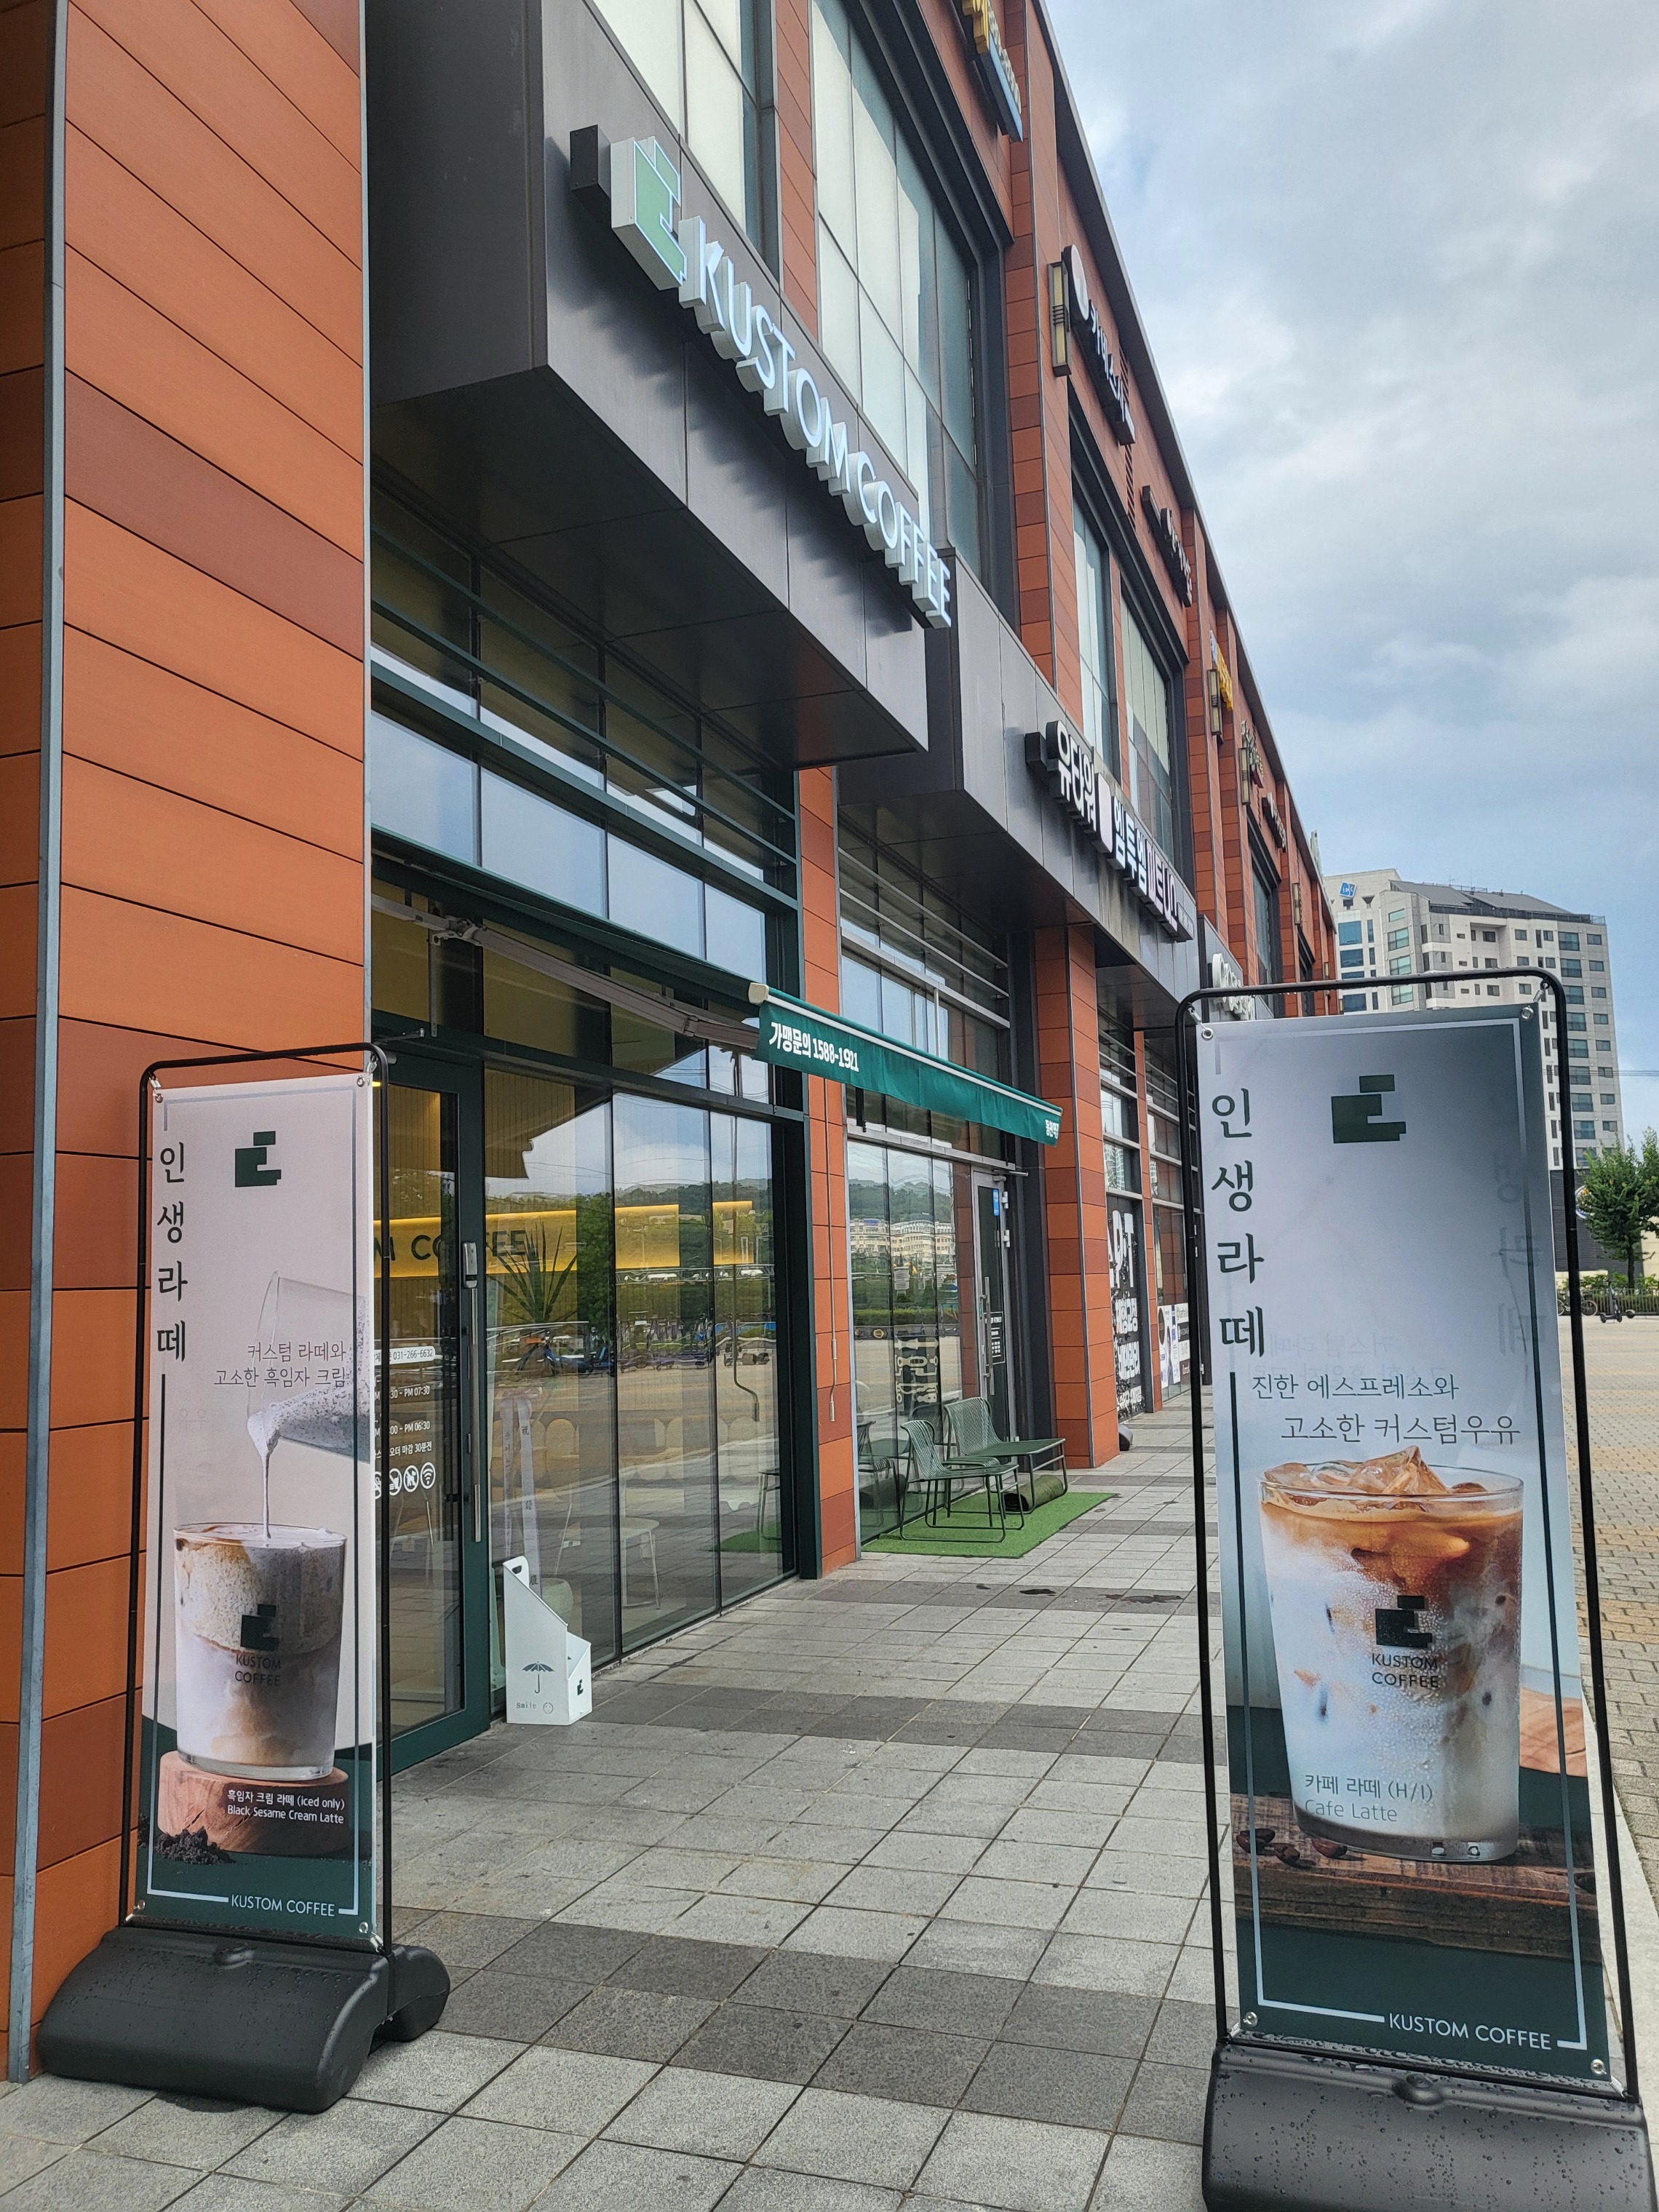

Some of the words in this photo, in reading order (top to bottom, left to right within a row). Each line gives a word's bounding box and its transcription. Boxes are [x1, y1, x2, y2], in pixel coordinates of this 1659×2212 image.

[687, 216, 850, 495] KUSTOM
[848, 453, 952, 629] COFFEE
[1055, 720, 1097, 834] 유타워
[768, 1022, 811, 1058] 가맹문의
[812, 1038, 859, 1073] 1588-1921
[248, 1341, 291, 1363] 커스텀
[298, 1340, 346, 1361] 라떼와
[393, 1348, 433, 1361] 031-266-6632
[213, 1367, 259, 1388] 고소한
[263, 1367, 310, 1388] 흑임자
[315, 1366, 346, 1388] 크림
[1251, 1374, 1299, 1401] 진한
[1307, 1374, 1460, 1401] 에스프레소와
[404, 1388, 413, 1397] PM
[414, 1385, 431, 1396] 07:30
[404, 1423, 413, 1433] PM
[414, 1420, 431, 1431] 06:30
[1281, 1412, 1365, 1444] 고소한
[1374, 1413, 1521, 1446] 커스텀우유
[402, 1444, 413, 1455] 마감
[414, 1441, 432, 1453] 30분전
[235, 1654, 282, 1670] KUSTOM
[1372, 1652, 1439, 1670] KUSTOM
[234, 1670, 281, 1687] COFFEE
[1372, 1671, 1439, 1688] COFFEE
[516, 1701, 536, 1709] Smile
[1305, 1774, 1339, 1795] 카페
[1346, 1778, 1381, 1799] 라떼
[227, 1789, 253, 1804] 흑임자
[255, 1792, 274, 1805] 크림
[276, 1794, 295, 1807] 라떼
[297, 1795, 319, 1808] (iced
[322, 1798, 346, 1811] only)
[1305, 1799, 1345, 1818] Cafe
[1351, 1802, 1398, 1822] Latte
[227, 1805, 251, 1817] Black
[252, 1807, 286, 1819] Sesame
[288, 1810, 317, 1823] Cream
[319, 1812, 344, 1824] Latte
[231, 1894, 282, 1912] KUSTOM
[286, 1900, 335, 1917] COFFEE
[1389, 2012, 1469, 2039] KUSTOM
[1475, 2024, 1552, 2050] COFFEE
